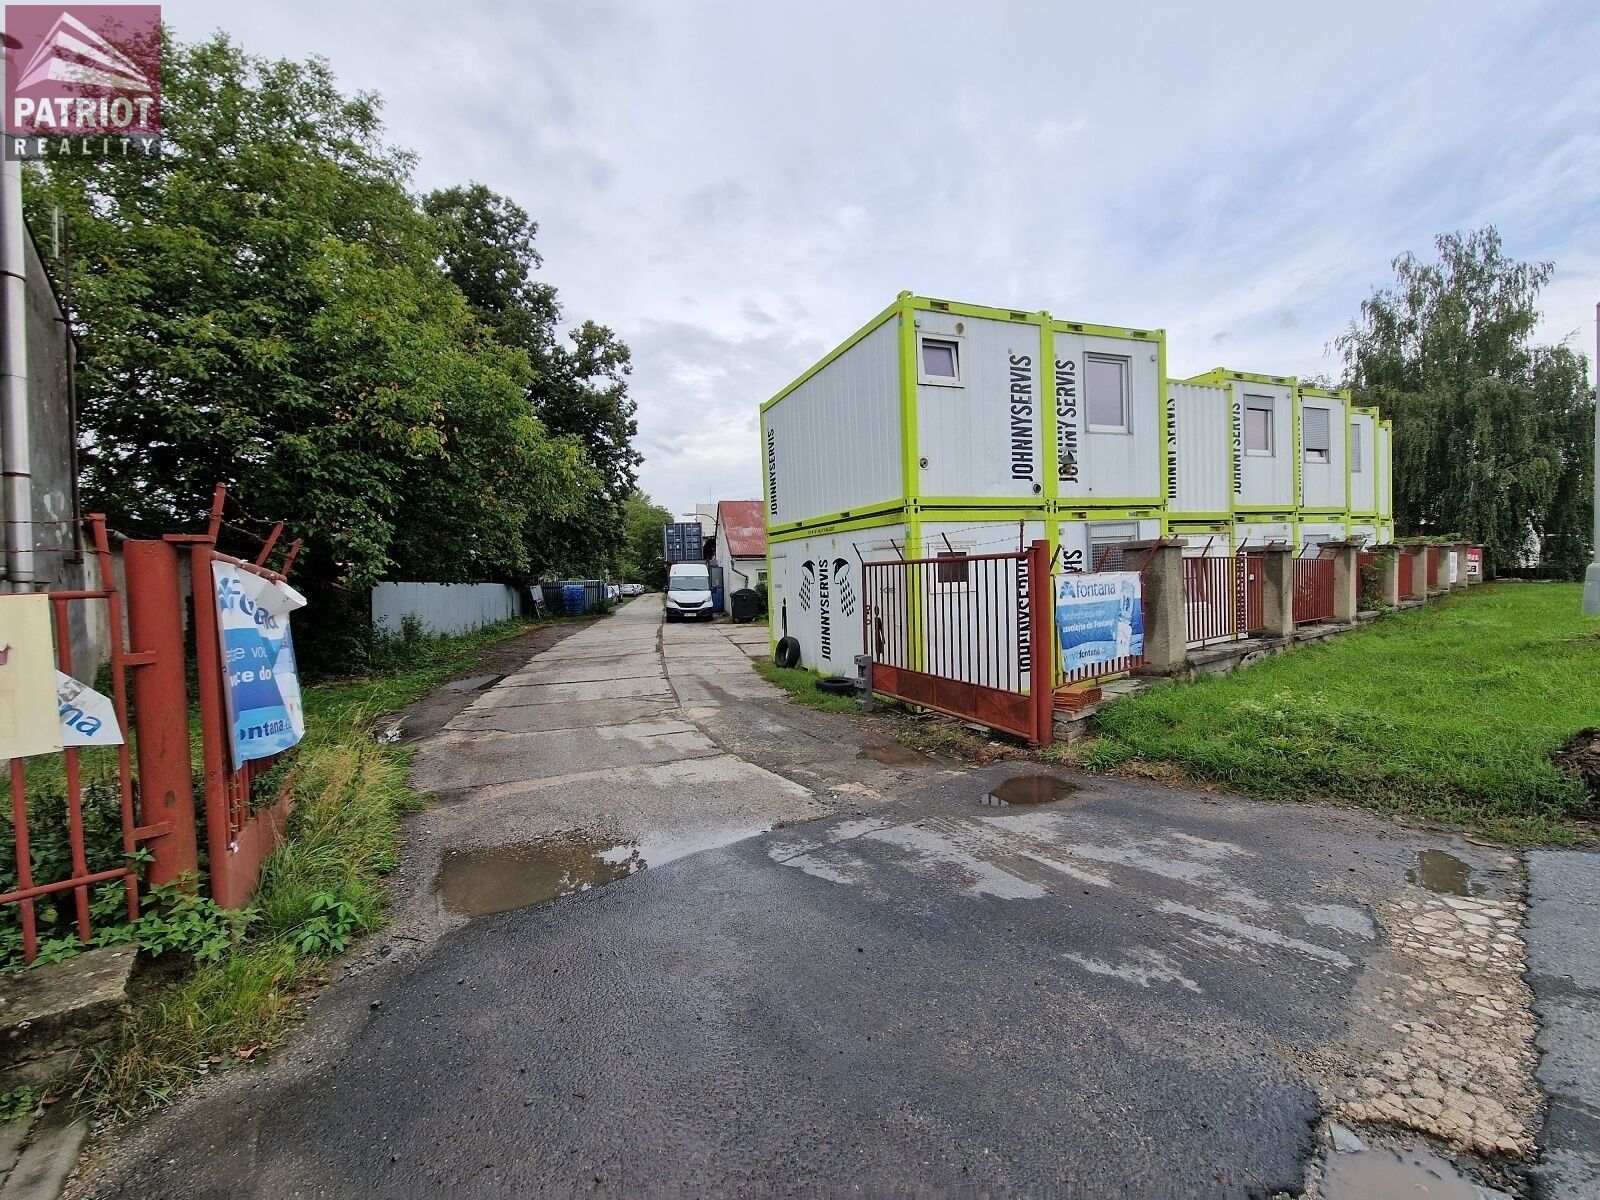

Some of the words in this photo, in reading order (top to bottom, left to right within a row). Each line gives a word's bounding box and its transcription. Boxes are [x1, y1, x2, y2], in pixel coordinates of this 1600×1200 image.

[1009, 354, 1034, 482] JOHNNYSERVIS
[767, 428, 778, 516] JOHNNYSERVIS
[818, 559, 832, 662] JOHNNYSERVIS
[1076, 581, 1116, 597] fontana
[259, 666, 272, 681] do
